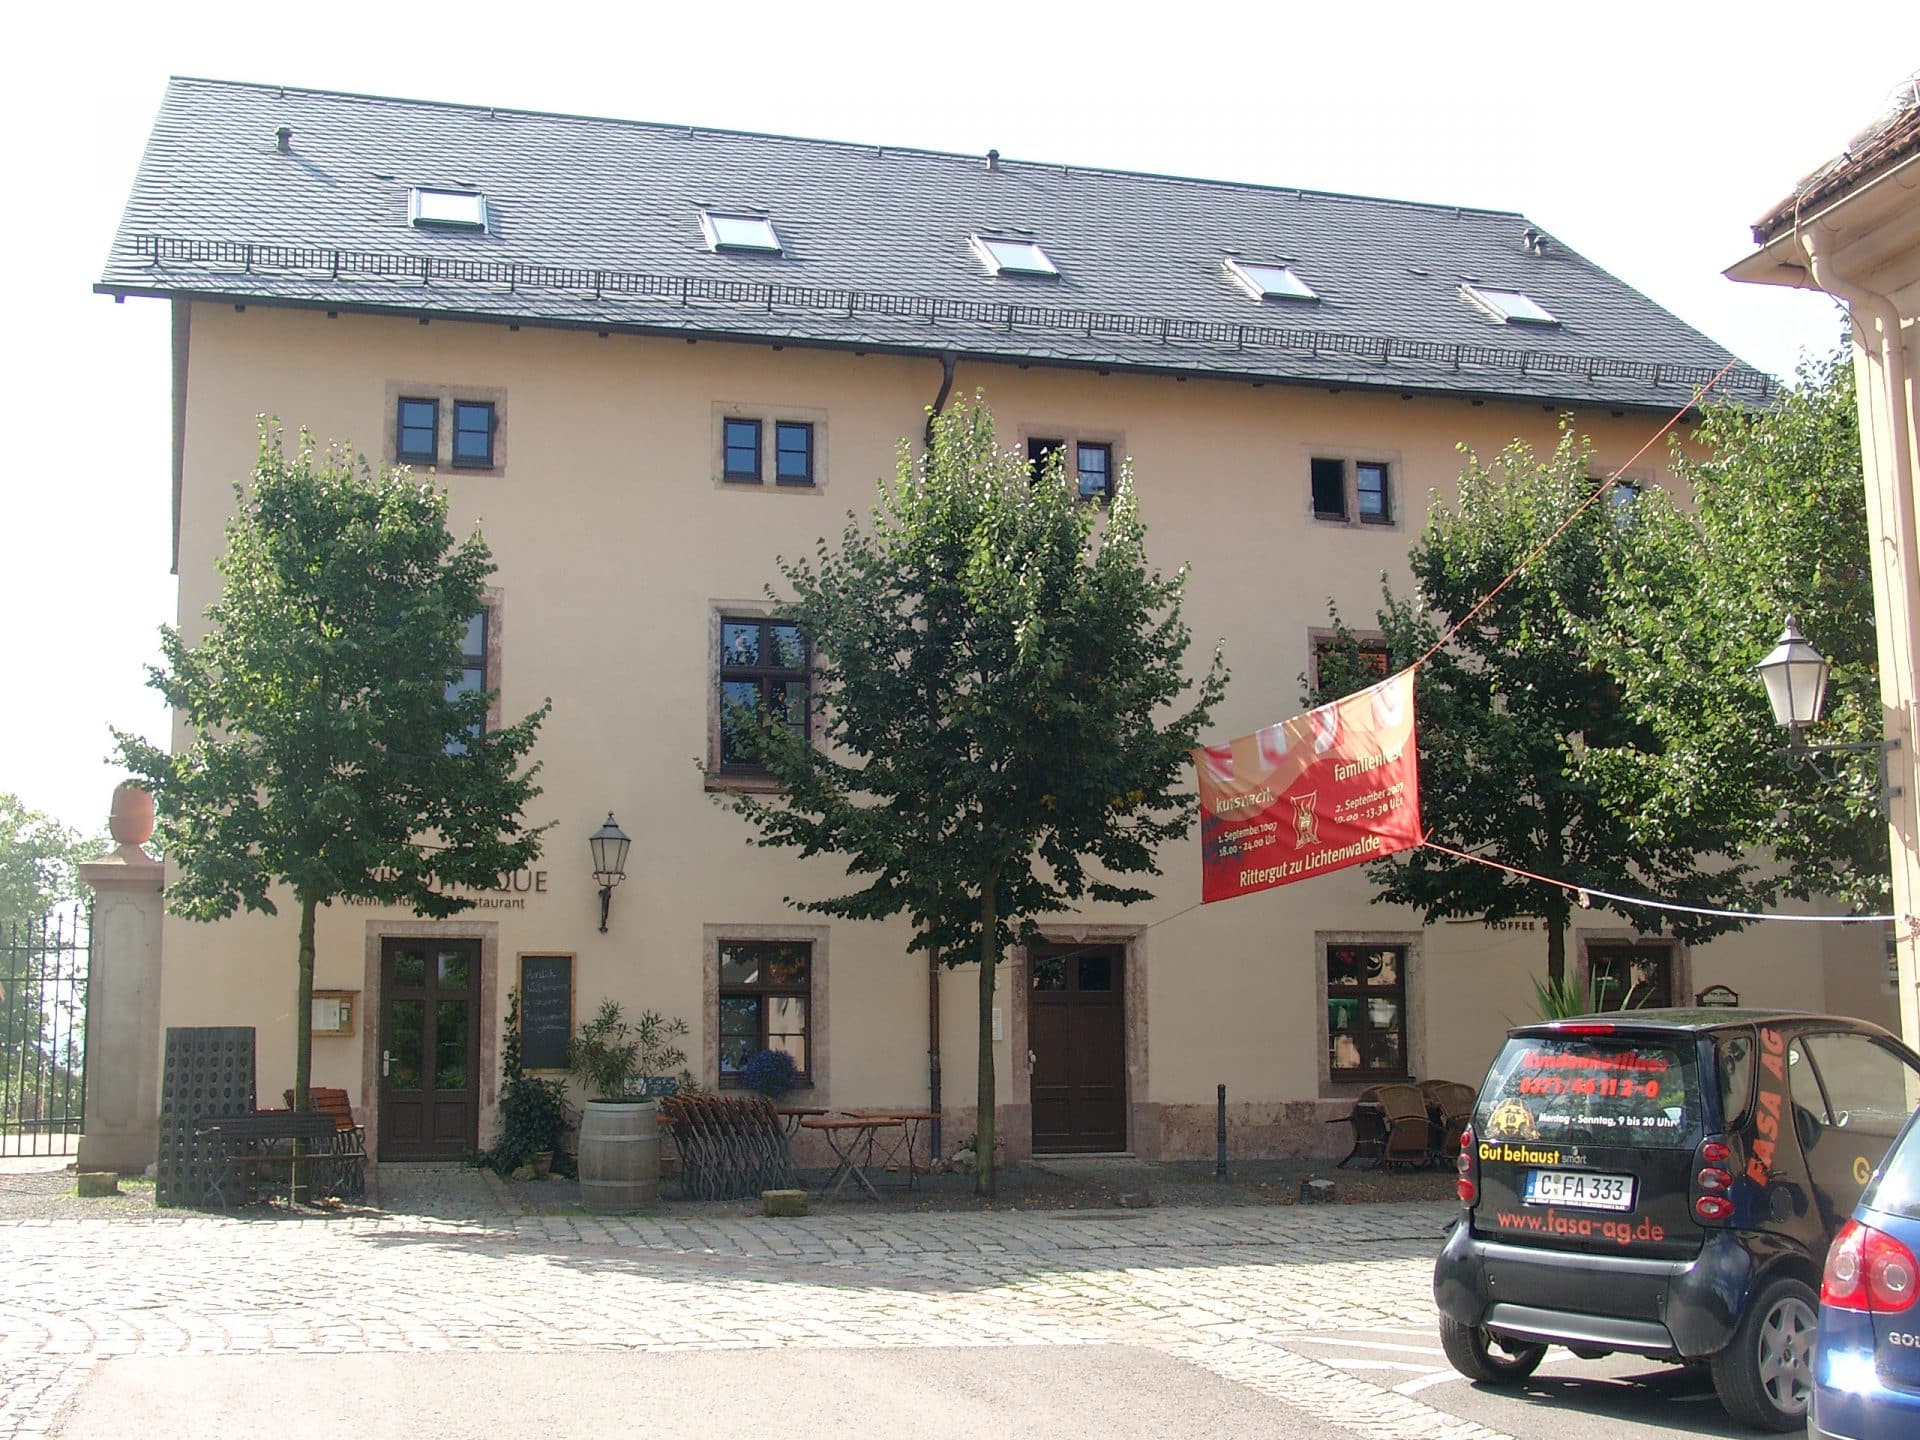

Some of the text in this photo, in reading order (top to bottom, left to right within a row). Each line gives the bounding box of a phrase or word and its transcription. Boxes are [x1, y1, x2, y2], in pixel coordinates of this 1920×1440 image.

[1334, 750, 1402, 781] familienes
[1345, 790, 1385, 810] September
[1219, 845, 1237, 856] 18.00
[1242, 838, 1263, 851] 24.00
[1240, 834, 1380, 887] Rittergut zu Lichtenwalde
[369, 868, 548, 893] VINOQUE
[1543, 921, 1571, 931] SP
[1539, 1112, 1570, 1125] Montag
[1578, 1114, 1616, 1127] Sonntag,
[1618, 1115, 1624, 1126] 9
[1627, 1114, 1640, 1126] bis
[1643, 1116, 1654, 1127] 20
[1657, 1115, 1675, 1127] Uhr
[1746, 1027, 1785, 1187] FASA AG
[1479, 1143, 1587, 1165] Gut behaust smart
[1541, 1175, 1624, 1200] C FA 333
[1497, 1208, 1665, 1246] www.fasa-ag.de
